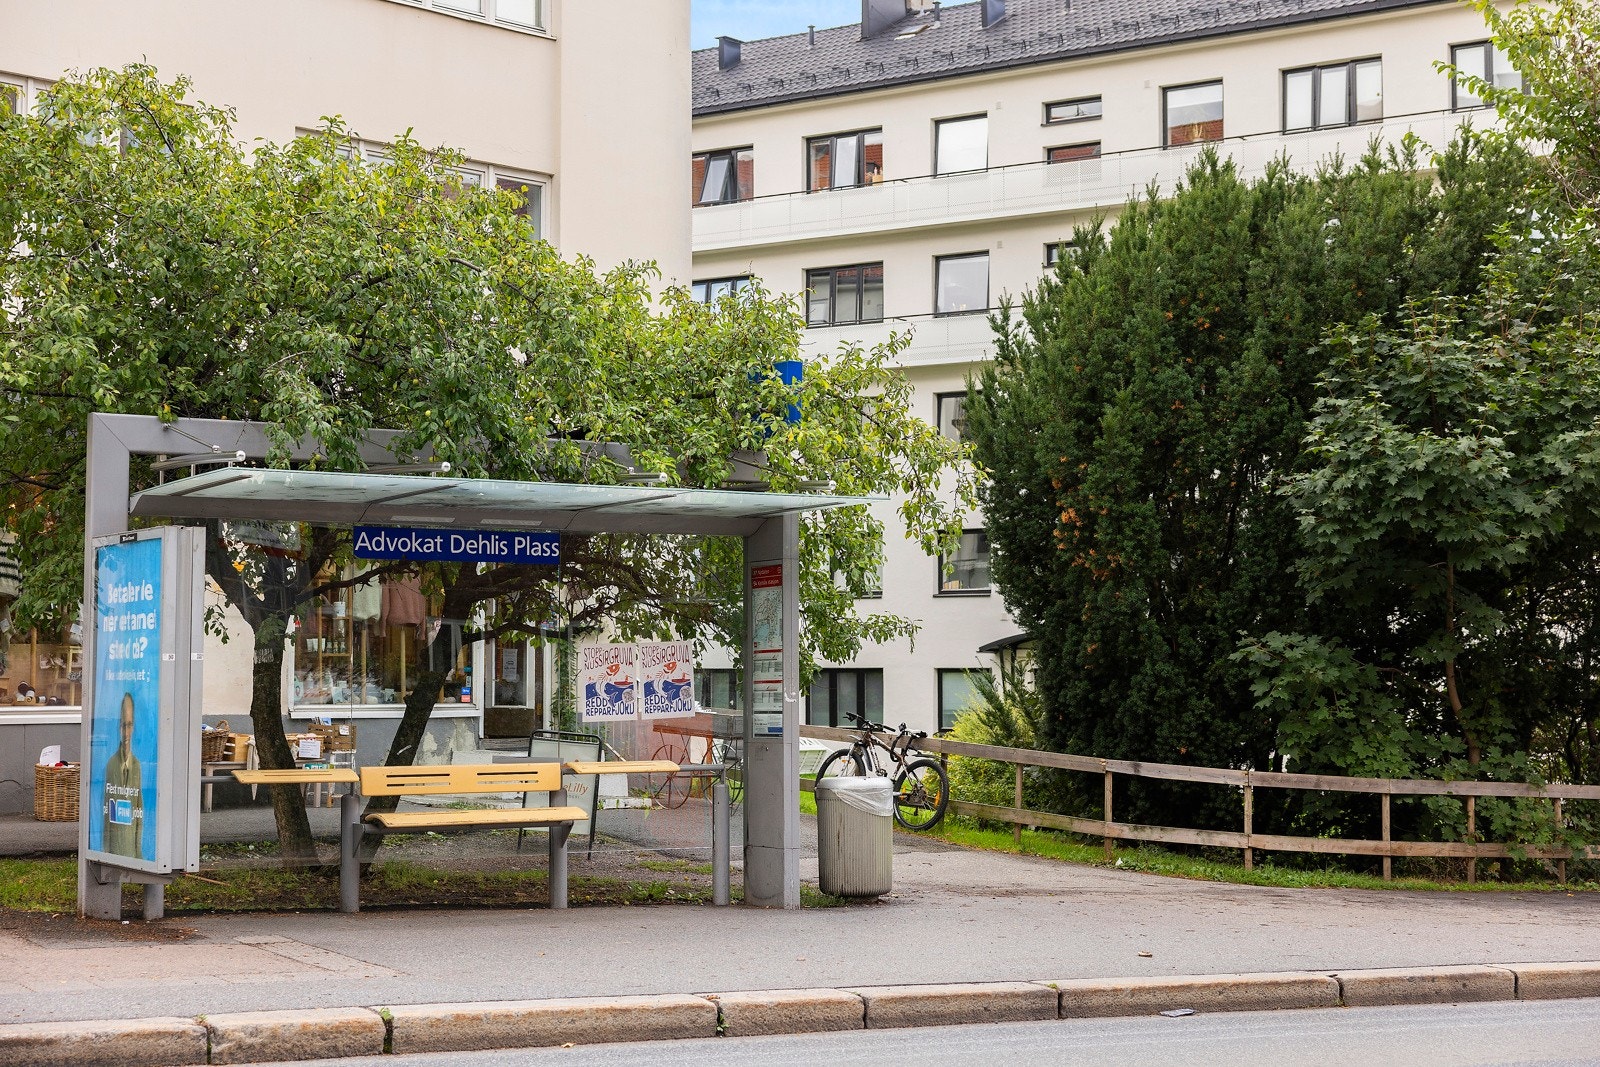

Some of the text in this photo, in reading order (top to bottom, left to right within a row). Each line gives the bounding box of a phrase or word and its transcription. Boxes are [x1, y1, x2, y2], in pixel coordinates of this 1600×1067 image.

[354, 530, 560, 557] Advokat Dehlis Plass
[585, 696, 609, 709] REDD
[644, 694, 666, 707] REDD
